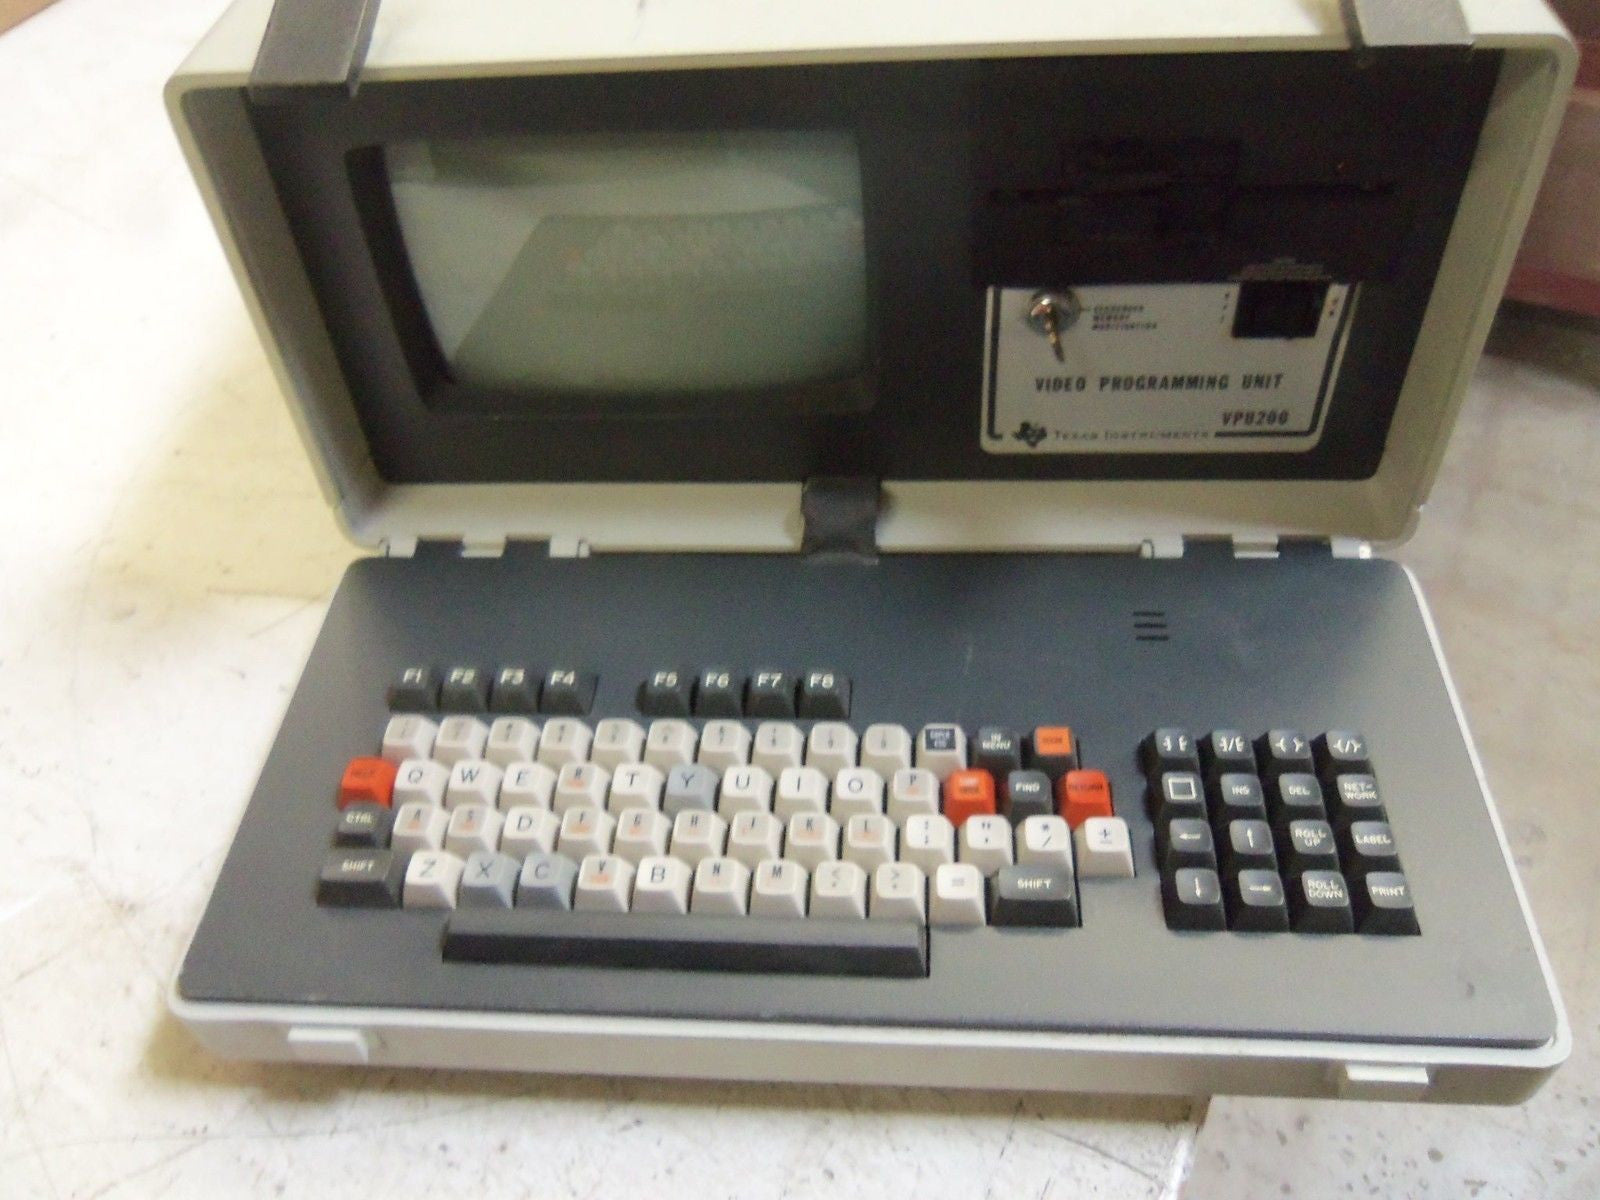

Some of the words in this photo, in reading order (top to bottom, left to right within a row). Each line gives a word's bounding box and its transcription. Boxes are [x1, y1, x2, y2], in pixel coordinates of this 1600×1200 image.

[1035, 375, 1087, 392] VIDEO
[1099, 374, 1230, 391] PROGRAMMING
[1242, 373, 1283, 389] UNIT
[402, 667, 423, 684] F1
[499, 667, 526, 686] F3
[550, 669, 576, 686] F4
[653, 671, 679, 688] F5
[705, 671, 730, 689] F6
[756, 672, 782, 688] F7
[809, 672, 834, 689] F8
[982, 741, 1011, 750] MENU
[407, 767, 424, 784] Q
[460, 767, 480, 784] W
[626, 771, 640, 787] T
[681, 771, 695, 788] Y
[735, 774, 750, 790] U
[909, 774, 918, 786] P
[796, 776, 802, 792] I
[847, 777, 864, 794] O
[1014, 782, 1041, 793] FIND
[1231, 784, 1250, 796] INS
[1288, 784, 1311, 796] DEL
[1344, 790, 1378, 800] WORK
[346, 810, 373, 825] CTRL
[1294, 827, 1327, 838] ROLL
[1354, 834, 1392, 845] LABEL
[1304, 838, 1321, 848] UP
[341, 859, 376, 873] SHIFT
[419, 858, 438, 877] Z
[476, 861, 494, 879] X
[534, 861, 550, 880] C
[598, 860, 607, 872] V
[650, 865, 666, 883] B
[712, 863, 721, 875] N
[771, 865, 783, 877] M
[1017, 878, 1052, 889] SHIFT
[1307, 878, 1339, 889] ROLL
[1371, 885, 1406, 897] PRINT
[1308, 888, 1344, 899] DOWN
